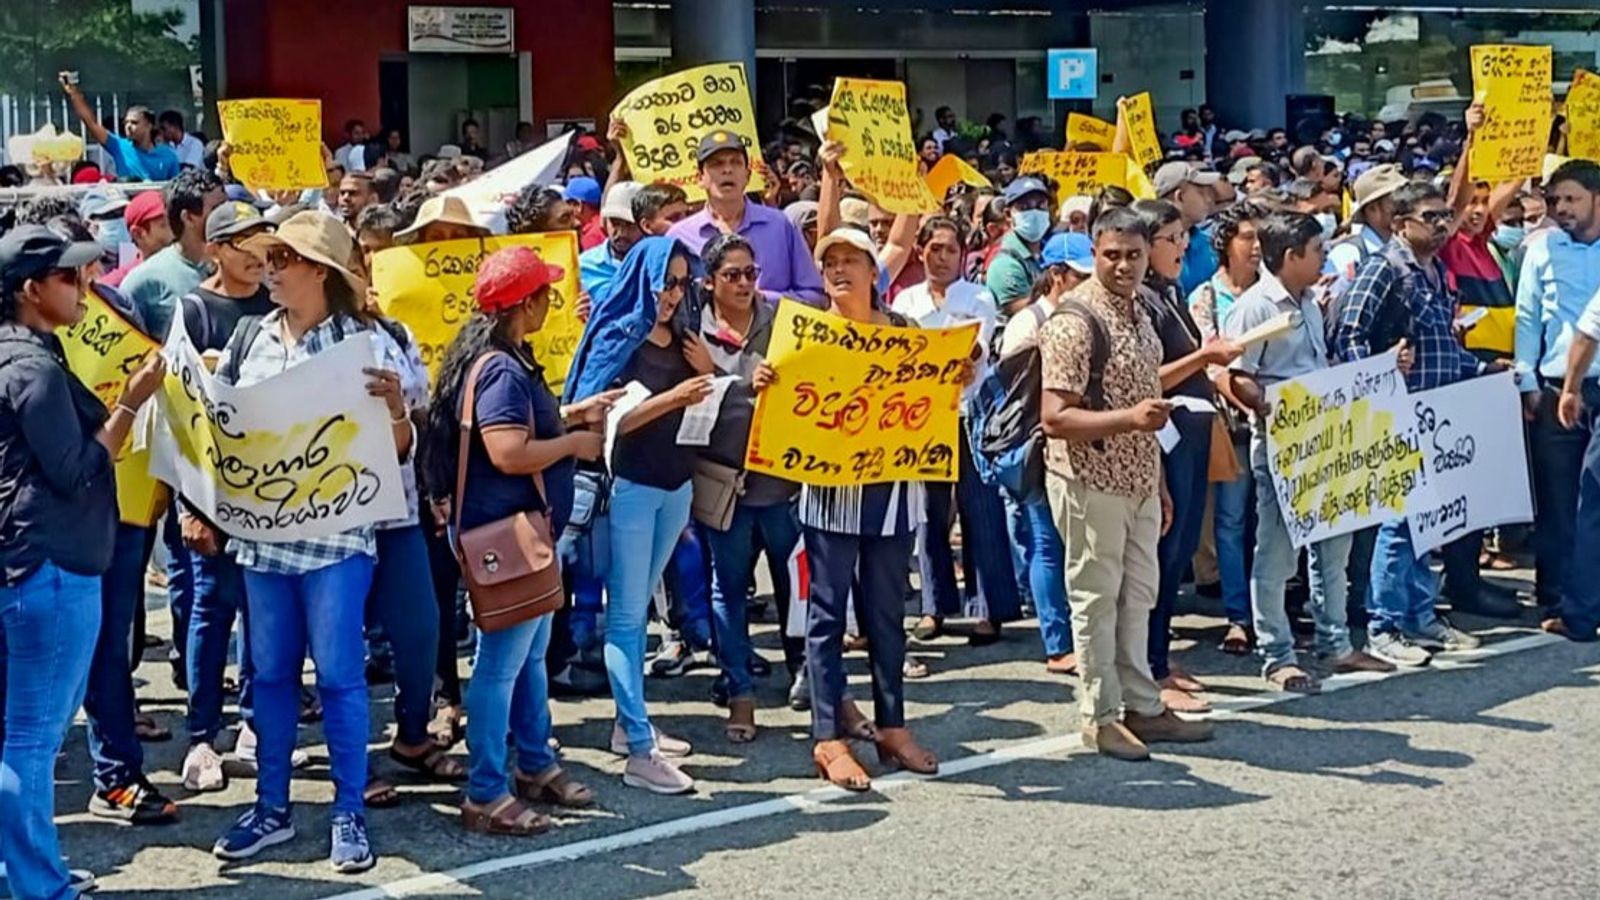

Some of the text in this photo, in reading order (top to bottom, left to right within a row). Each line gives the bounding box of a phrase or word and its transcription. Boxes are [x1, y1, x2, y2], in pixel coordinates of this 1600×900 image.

[703, 75, 736, 93] මත
[1059, 59, 1086, 90] P
[654, 113, 682, 135] බර
[633, 143, 682, 171] විදුලි
[792, 381, 932, 436] විදුලි බිල
[1270, 388, 1347, 436] இலங்கை
[850, 446, 887, 480] අඩු
